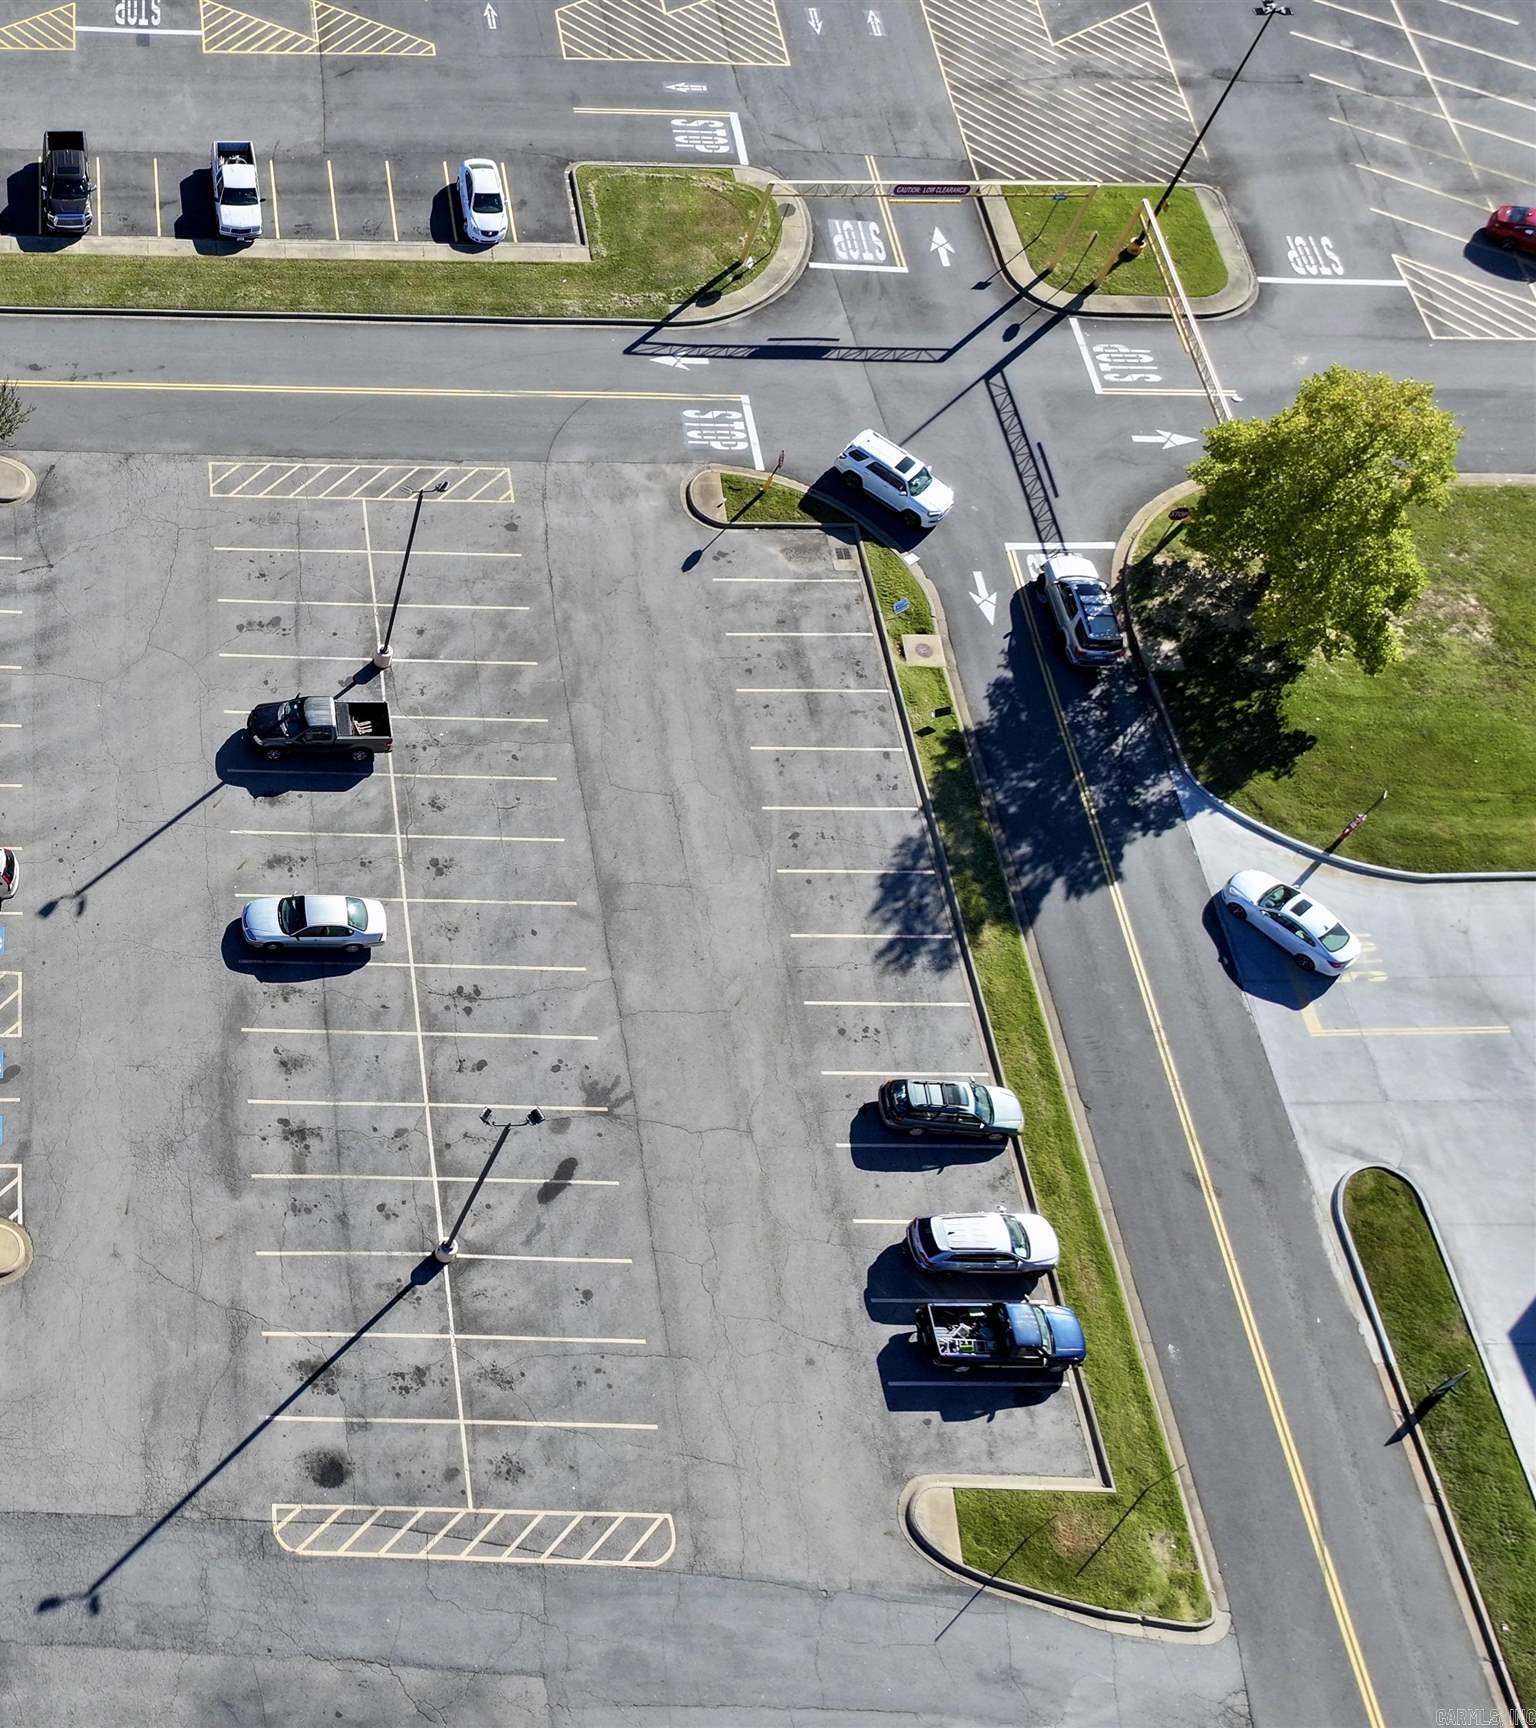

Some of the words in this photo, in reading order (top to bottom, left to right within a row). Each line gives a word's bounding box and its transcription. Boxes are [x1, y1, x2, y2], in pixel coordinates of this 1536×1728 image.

[670, 118, 730, 153] STOP
[832, 220, 887, 261] STOP
[1286, 235, 1344, 276] STOP
[1092, 343, 1162, 382] STOP
[682, 409, 749, 450] STOP
